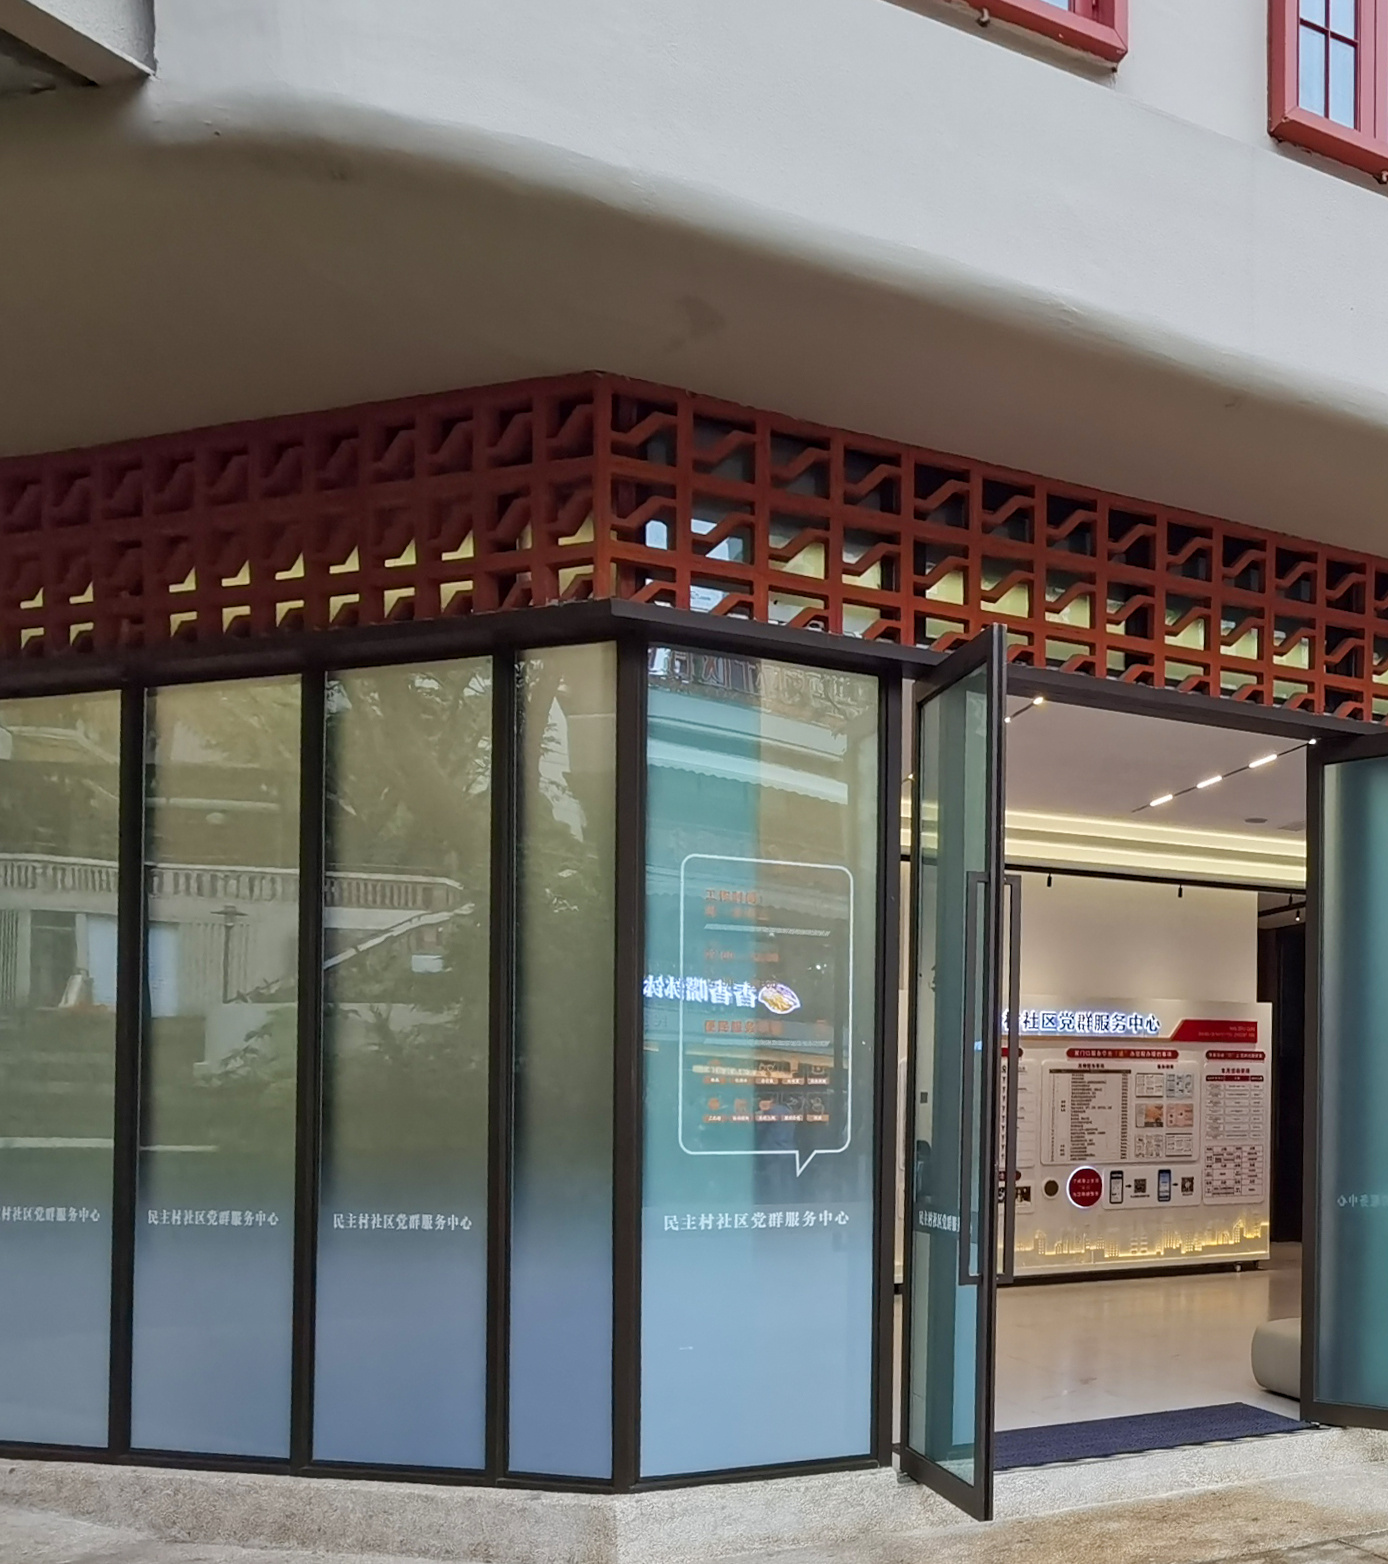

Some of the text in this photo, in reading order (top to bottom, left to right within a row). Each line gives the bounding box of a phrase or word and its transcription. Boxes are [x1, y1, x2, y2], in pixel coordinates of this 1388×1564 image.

[147, 1208, 280, 1227] 民主村社区党群服务中心
[333, 1211, 473, 1232] 民主村社区党群服务中心
[663, 1210, 850, 1232] 民主村社区党群服务中心
